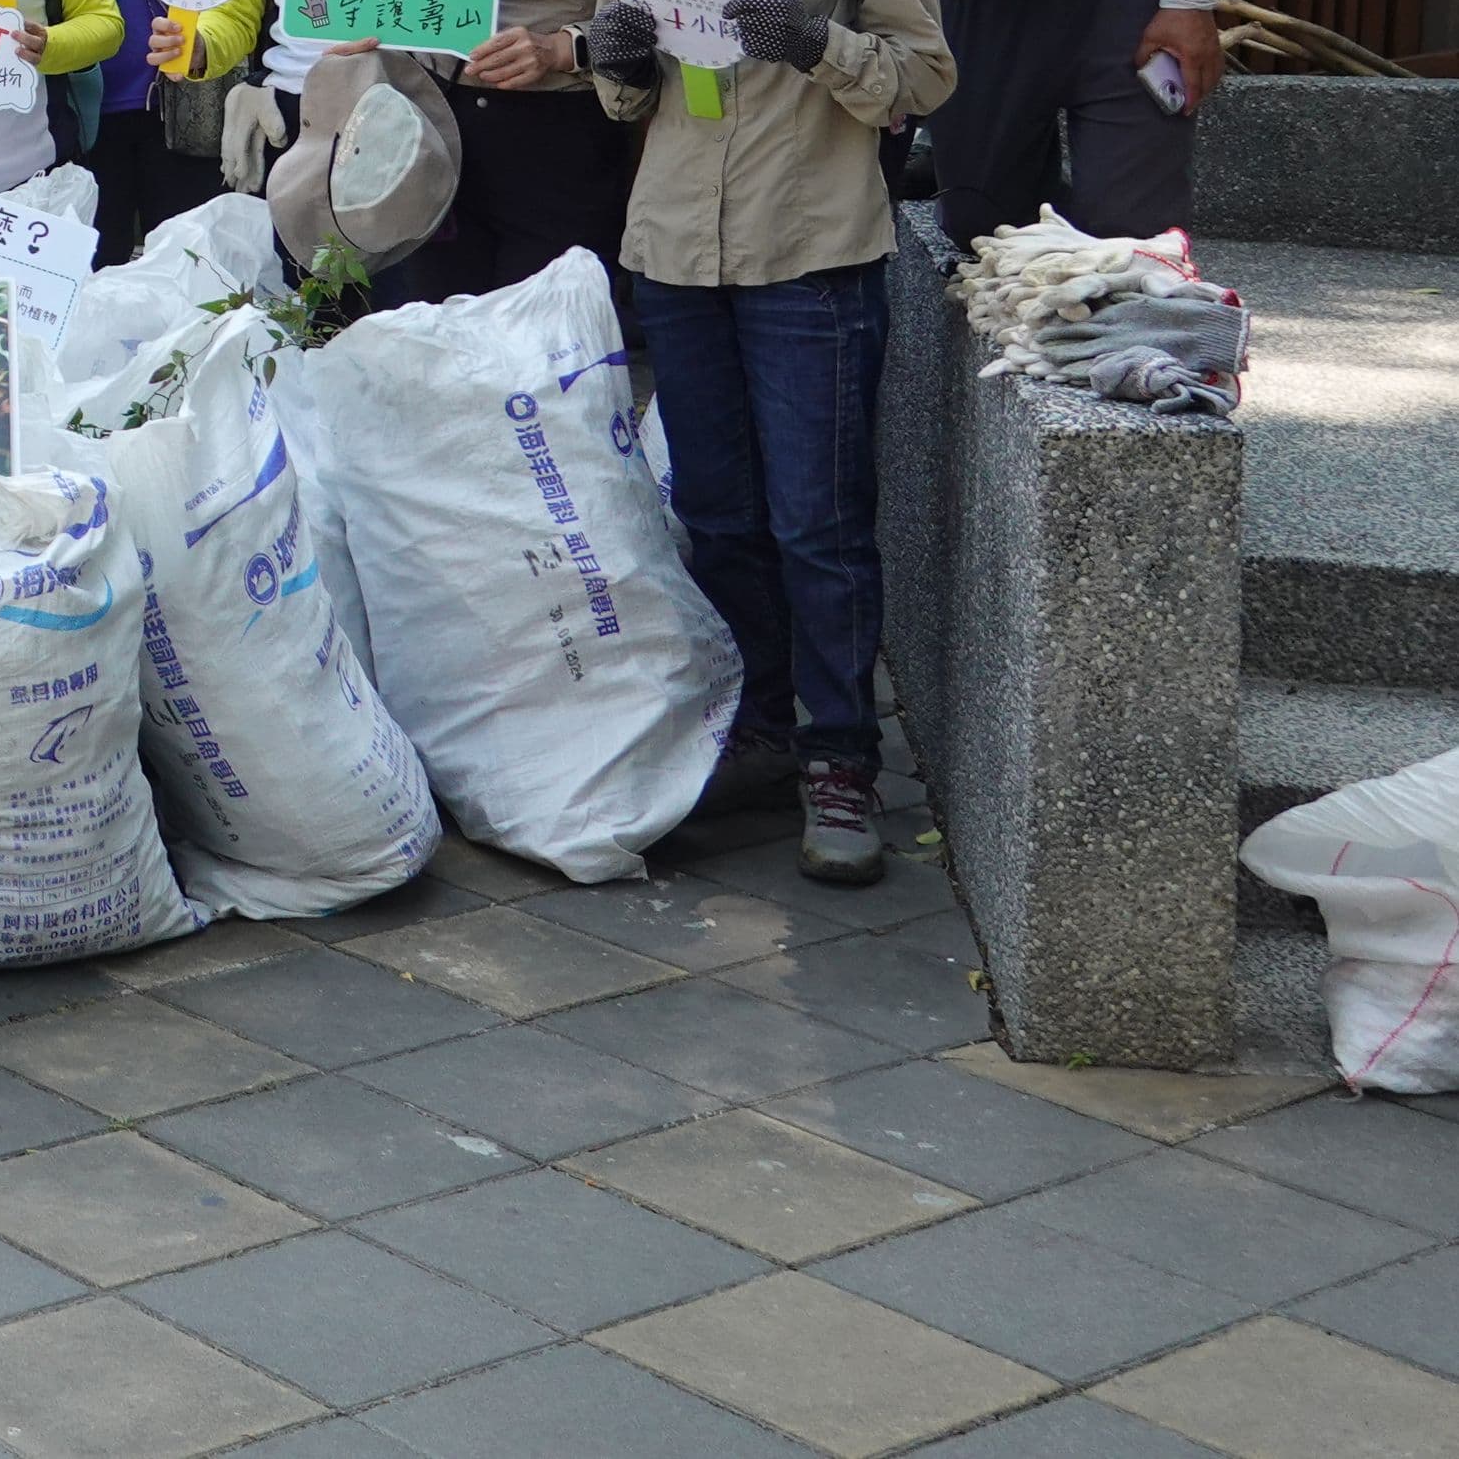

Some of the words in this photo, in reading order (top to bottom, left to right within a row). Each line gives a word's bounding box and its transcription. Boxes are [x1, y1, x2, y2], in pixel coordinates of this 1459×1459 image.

[514, 422, 579, 526] 海洋飼料
[562, 530, 621, 639] 虱目魚專用
[171, 695, 250, 803] 虱目魚專用
